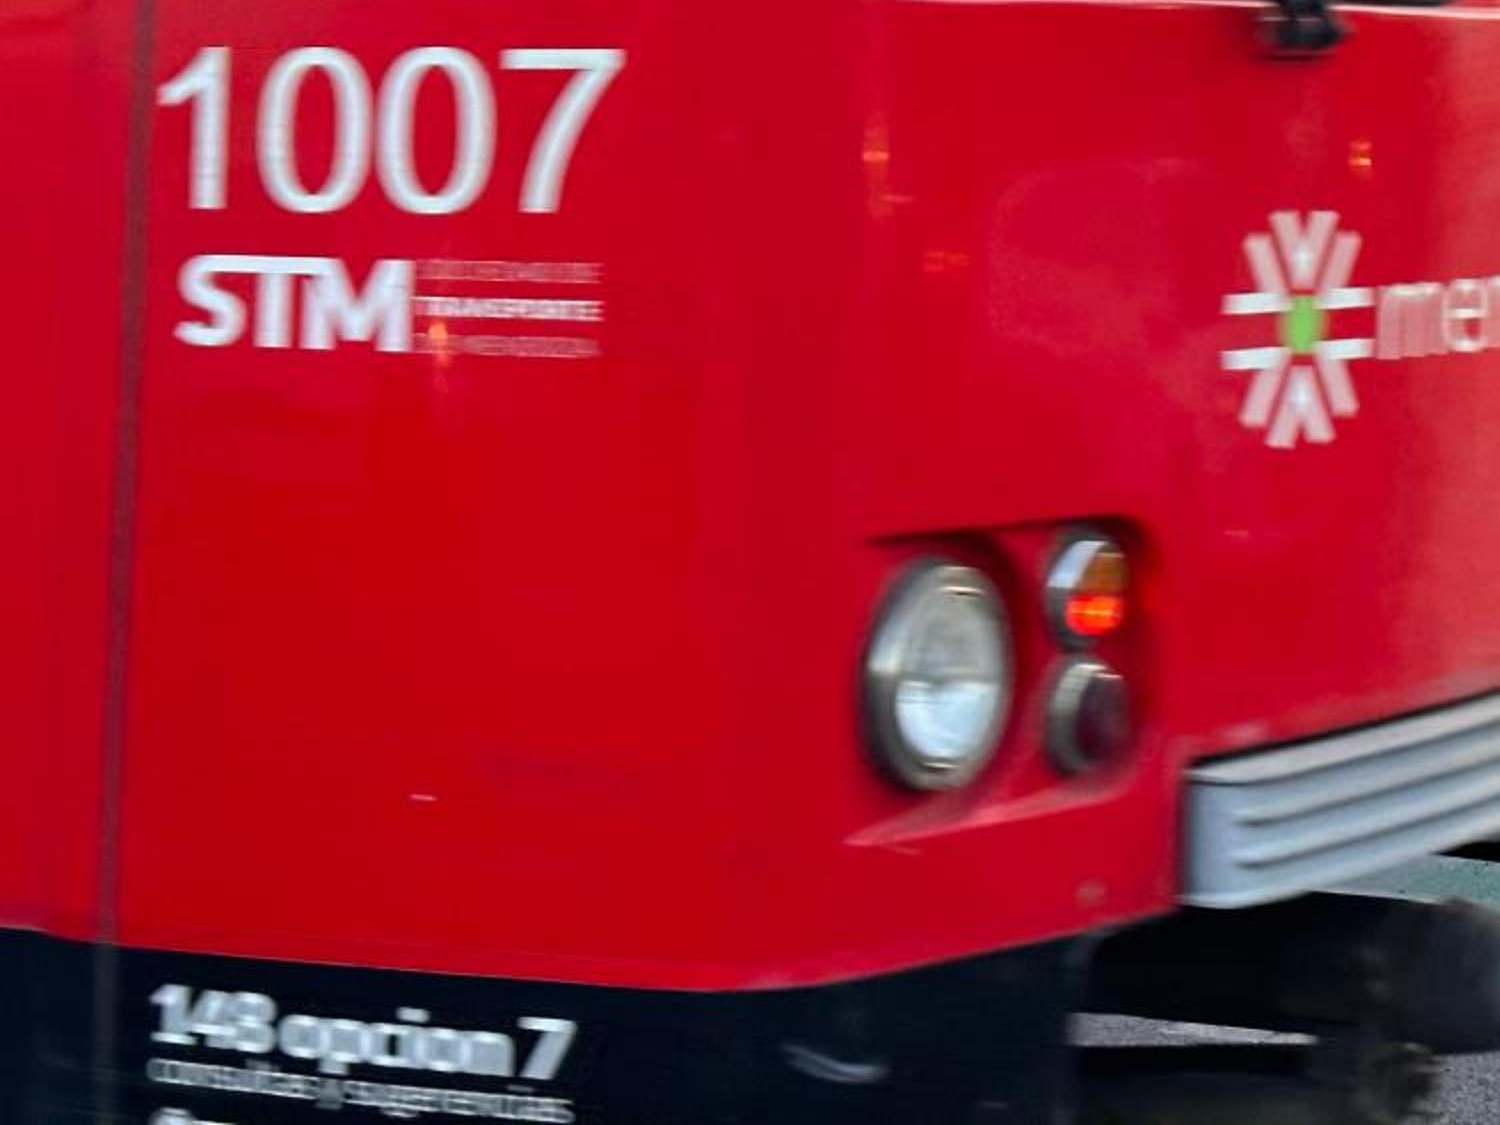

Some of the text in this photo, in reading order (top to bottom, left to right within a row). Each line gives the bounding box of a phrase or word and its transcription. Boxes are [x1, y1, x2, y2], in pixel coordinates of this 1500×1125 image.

[157, 46, 627, 214] 1007
[173, 255, 416, 352] STM
[148, 983, 278, 1054] 148
[516, 1016, 578, 1081] 7
